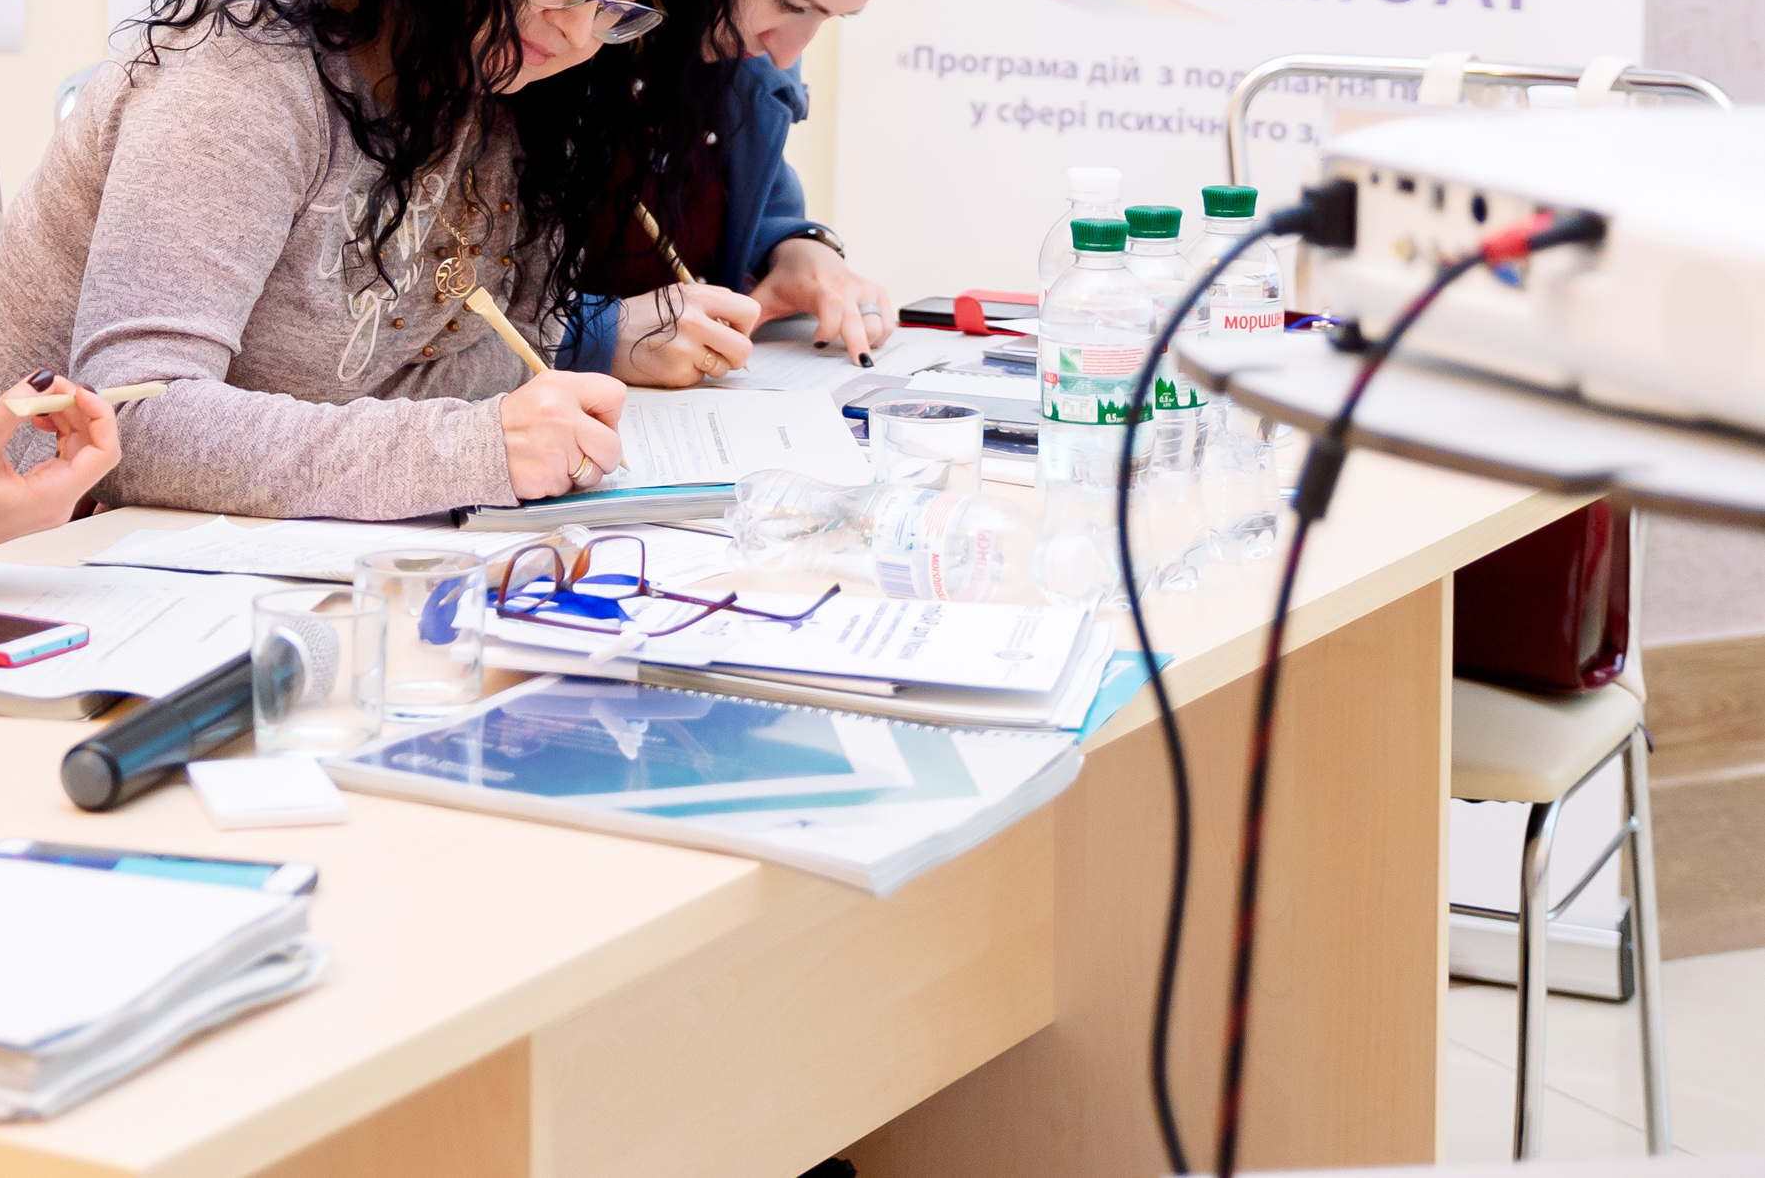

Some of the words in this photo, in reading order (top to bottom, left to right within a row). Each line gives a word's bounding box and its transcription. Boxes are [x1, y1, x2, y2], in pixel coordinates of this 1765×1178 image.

[895, 43, 1080, 83] «Програма
[1086, 56, 1141, 87] дій
[1158, 65, 1175, 87] з
[969, 101, 988, 128] у
[995, 96, 1088, 133] сфері
[1097, 106, 1288, 142] психічнго
